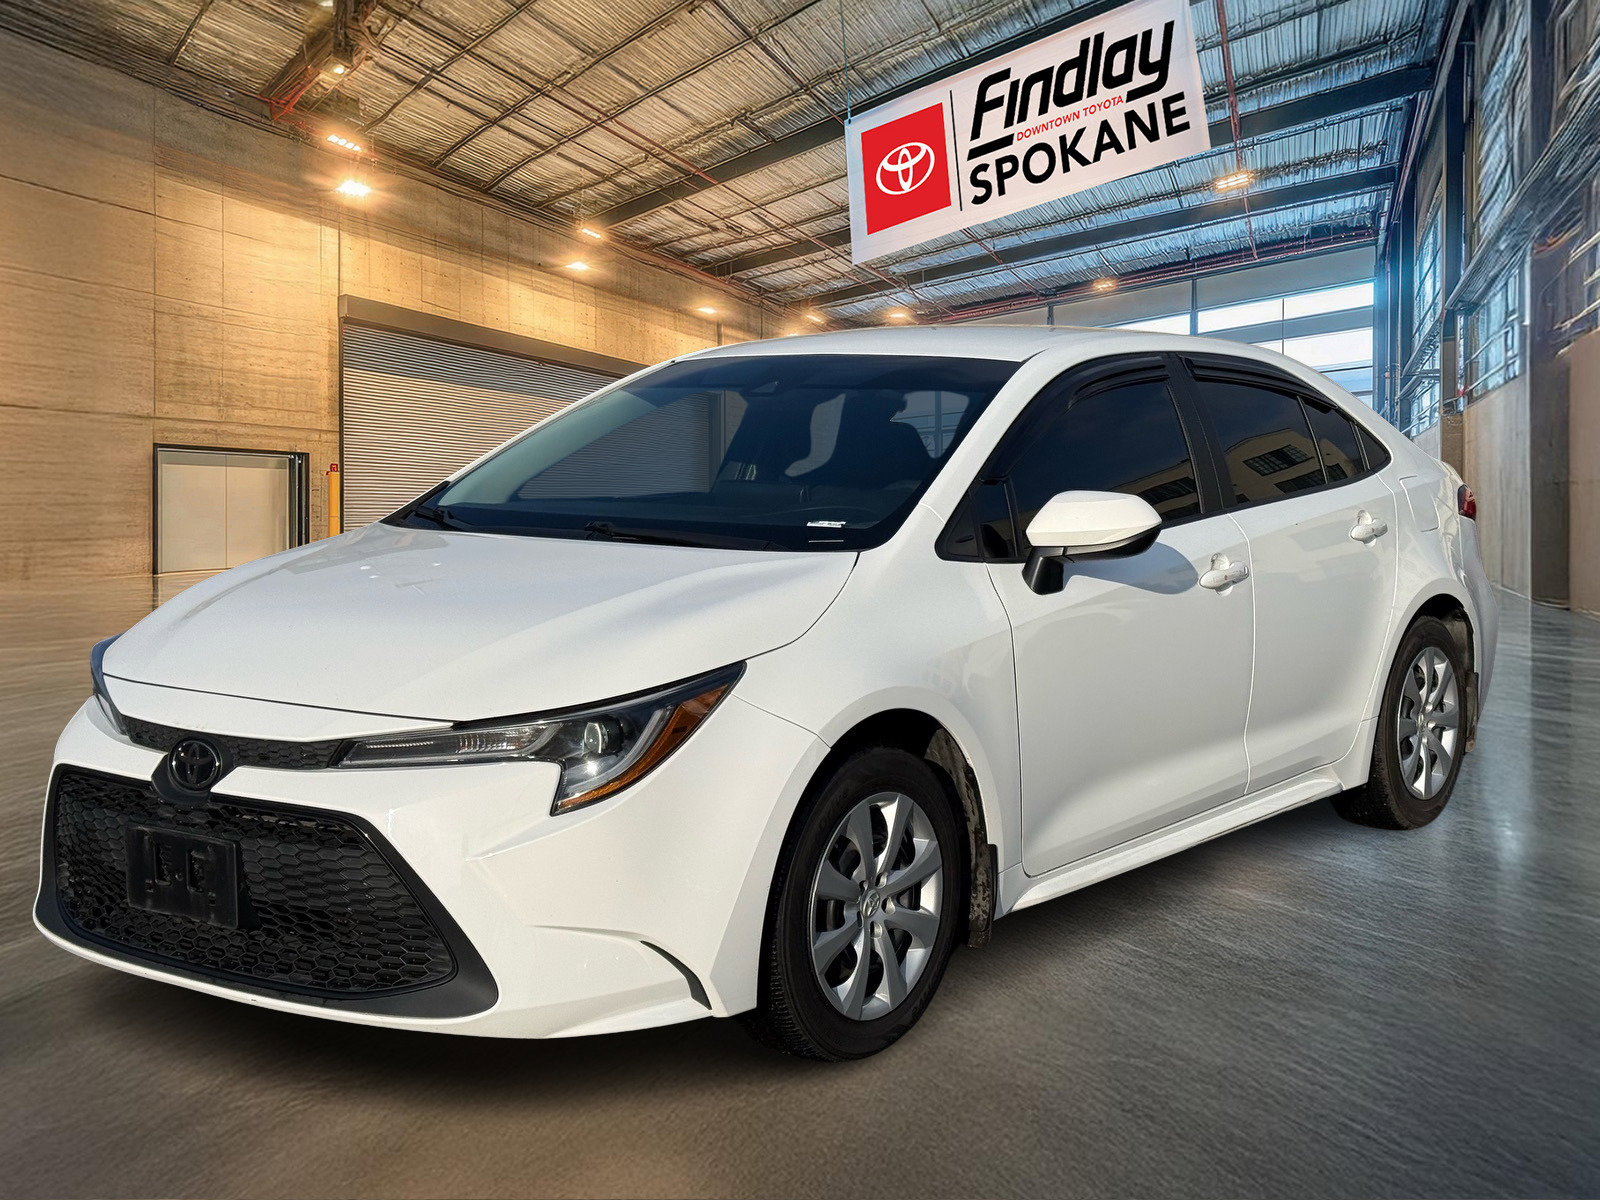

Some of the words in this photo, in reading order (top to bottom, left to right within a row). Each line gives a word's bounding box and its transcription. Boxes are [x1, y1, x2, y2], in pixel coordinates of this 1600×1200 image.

[970, 20, 1175, 141] Findlay
[1016, 111, 1080, 141] DOWNTOWN
[1082, 95, 1124, 117] TOYOTA
[969, 91, 1191, 205] SPOKANE
